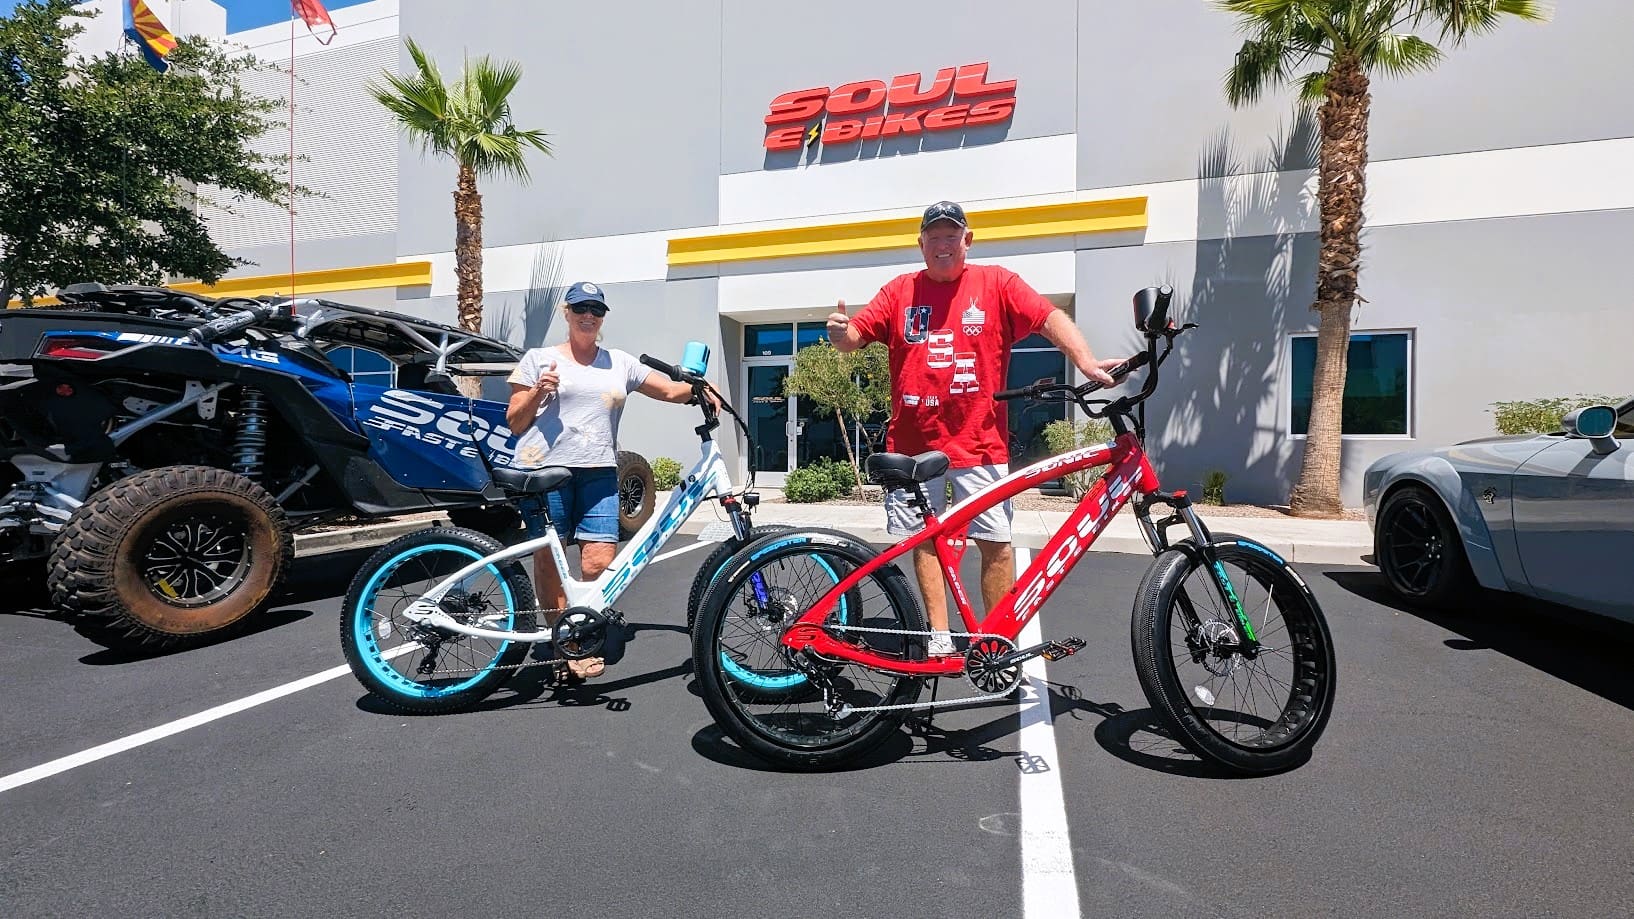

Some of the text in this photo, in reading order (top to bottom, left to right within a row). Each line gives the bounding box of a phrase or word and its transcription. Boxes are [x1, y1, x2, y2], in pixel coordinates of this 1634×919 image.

[764, 62, 1017, 124] SOUL
[764, 97, 1016, 149] E BIKES
[925, 398, 939, 406] USA
[363, 416, 462, 449] FAST
[1023, 447, 1100, 479] SONIC
[602, 471, 716, 604] SOUL
[1013, 466, 1142, 622] SOUL
